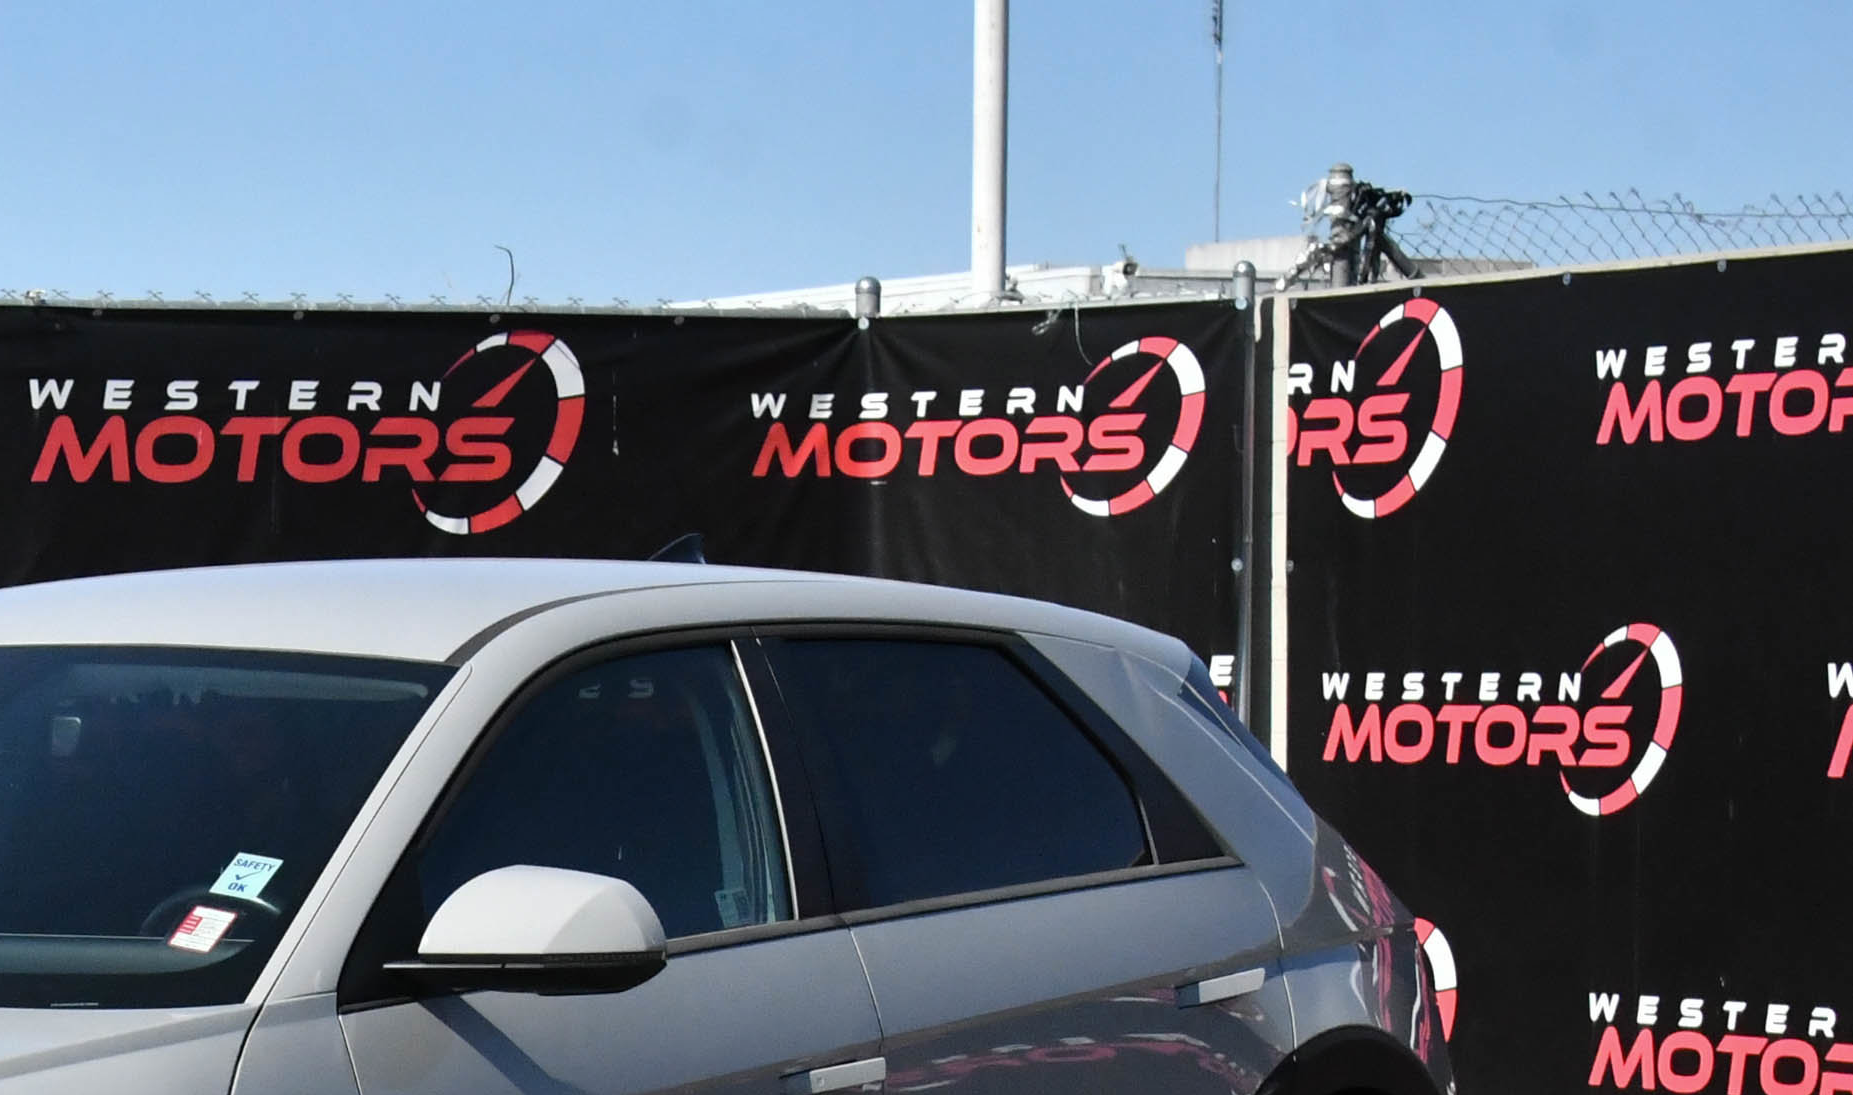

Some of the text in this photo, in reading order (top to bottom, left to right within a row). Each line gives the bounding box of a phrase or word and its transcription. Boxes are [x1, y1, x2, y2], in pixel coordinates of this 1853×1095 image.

[1595, 332, 1847, 380] WESTER
[29, 378, 441, 411] WESTERN
[750, 384, 1085, 419] WESTERN
[31, 415, 515, 482] MOTORS
[752, 412, 1147, 478] MOTORS
[1321, 671, 1582, 702] WESTERN
[1322, 701, 1634, 768] MOTORS
[233, 858, 276, 872] SAFETY
[227, 882, 248, 892] OK
[1588, 992, 1837, 1039] WESTER
